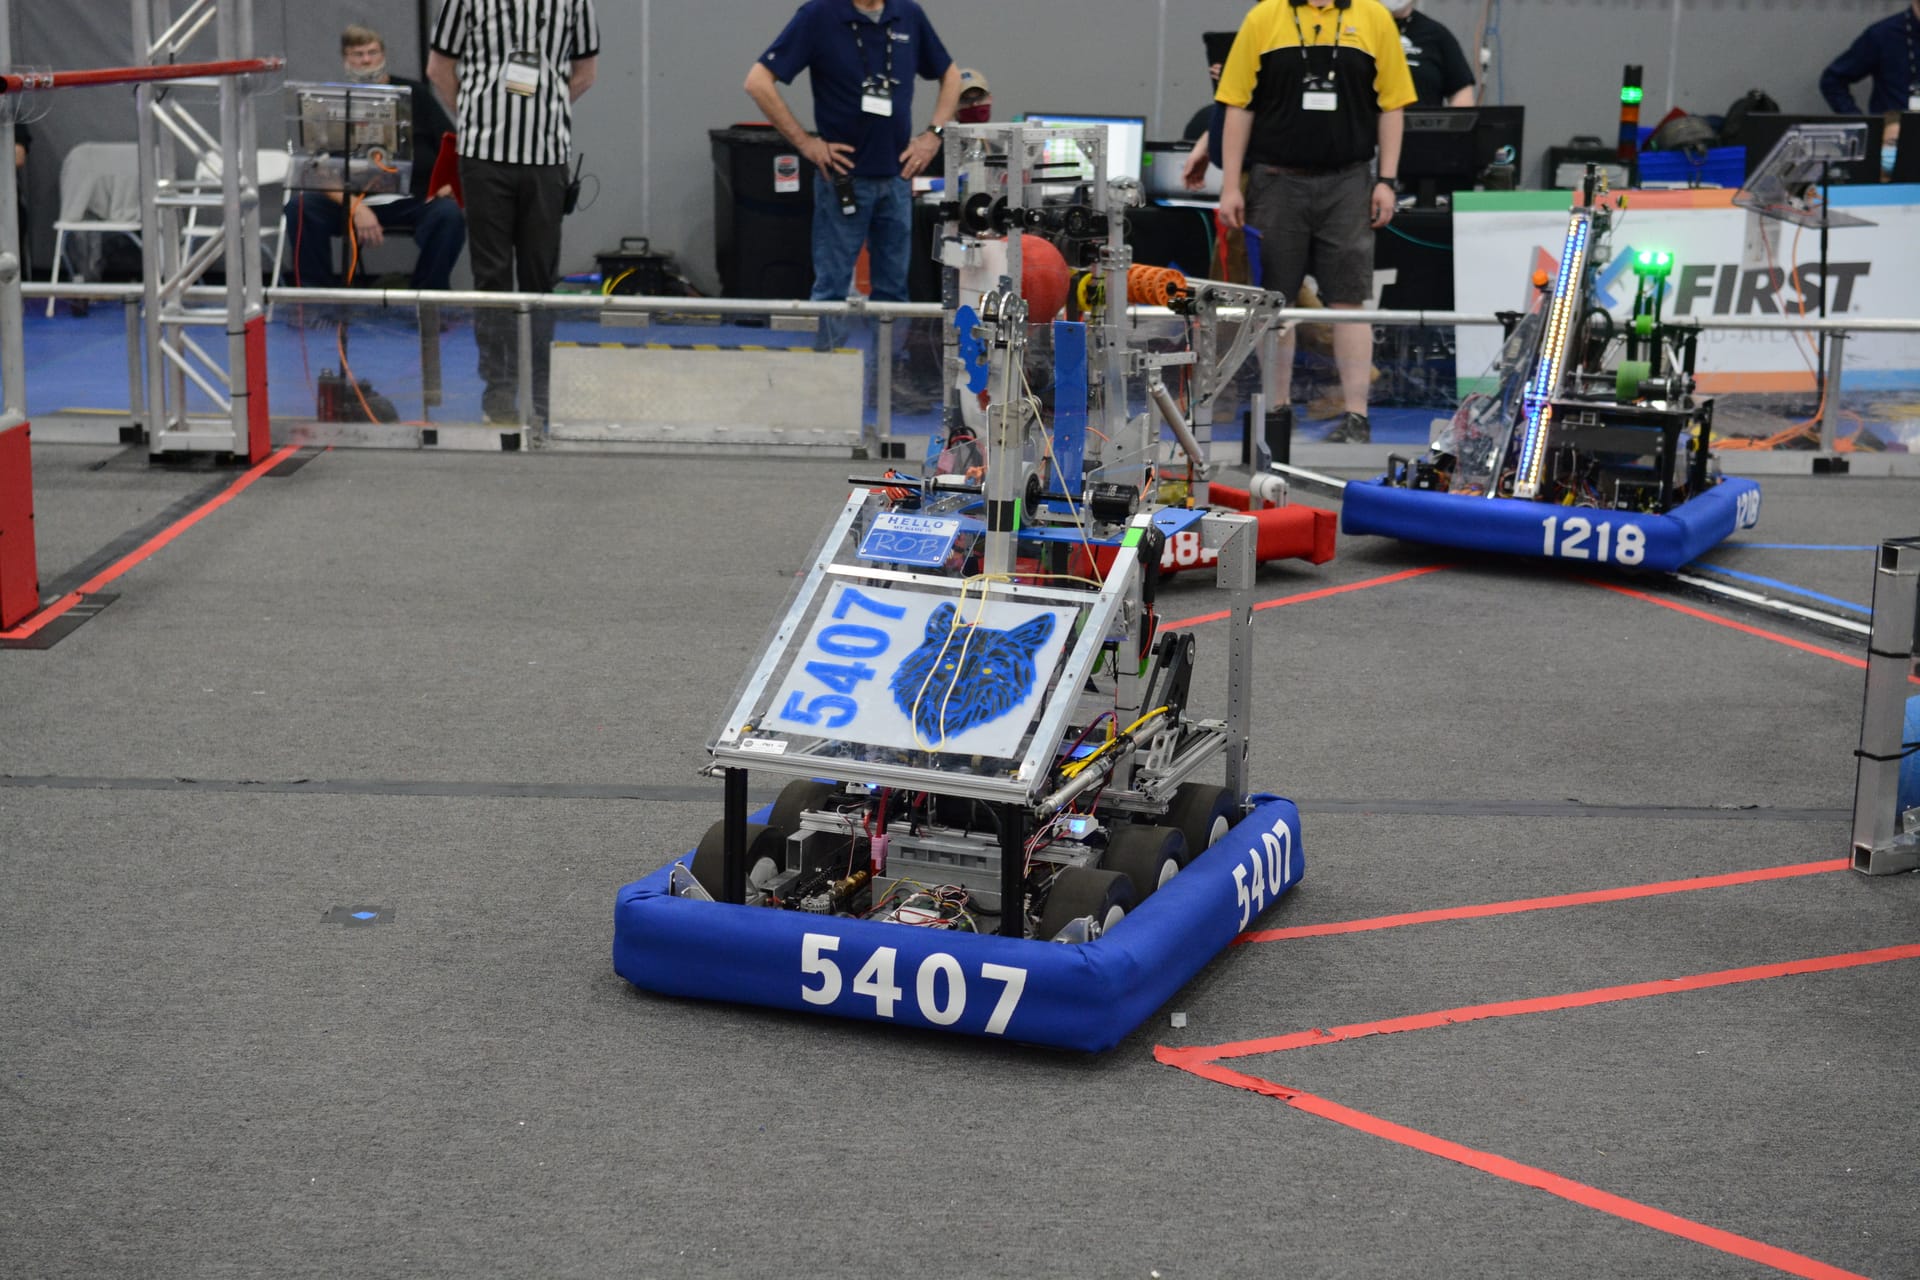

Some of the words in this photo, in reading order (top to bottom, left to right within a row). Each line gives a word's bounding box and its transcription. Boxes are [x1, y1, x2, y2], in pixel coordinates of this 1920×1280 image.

[1674, 261, 1871, 315] FIRST
[872, 532, 938, 555] ROB
[887, 516, 944, 529] HELLO
[1542, 515, 1646, 566] 1218
[779, 587, 908, 729] 5407
[1231, 818, 1292, 934] 5407
[800, 932, 1028, 1035] 5407
